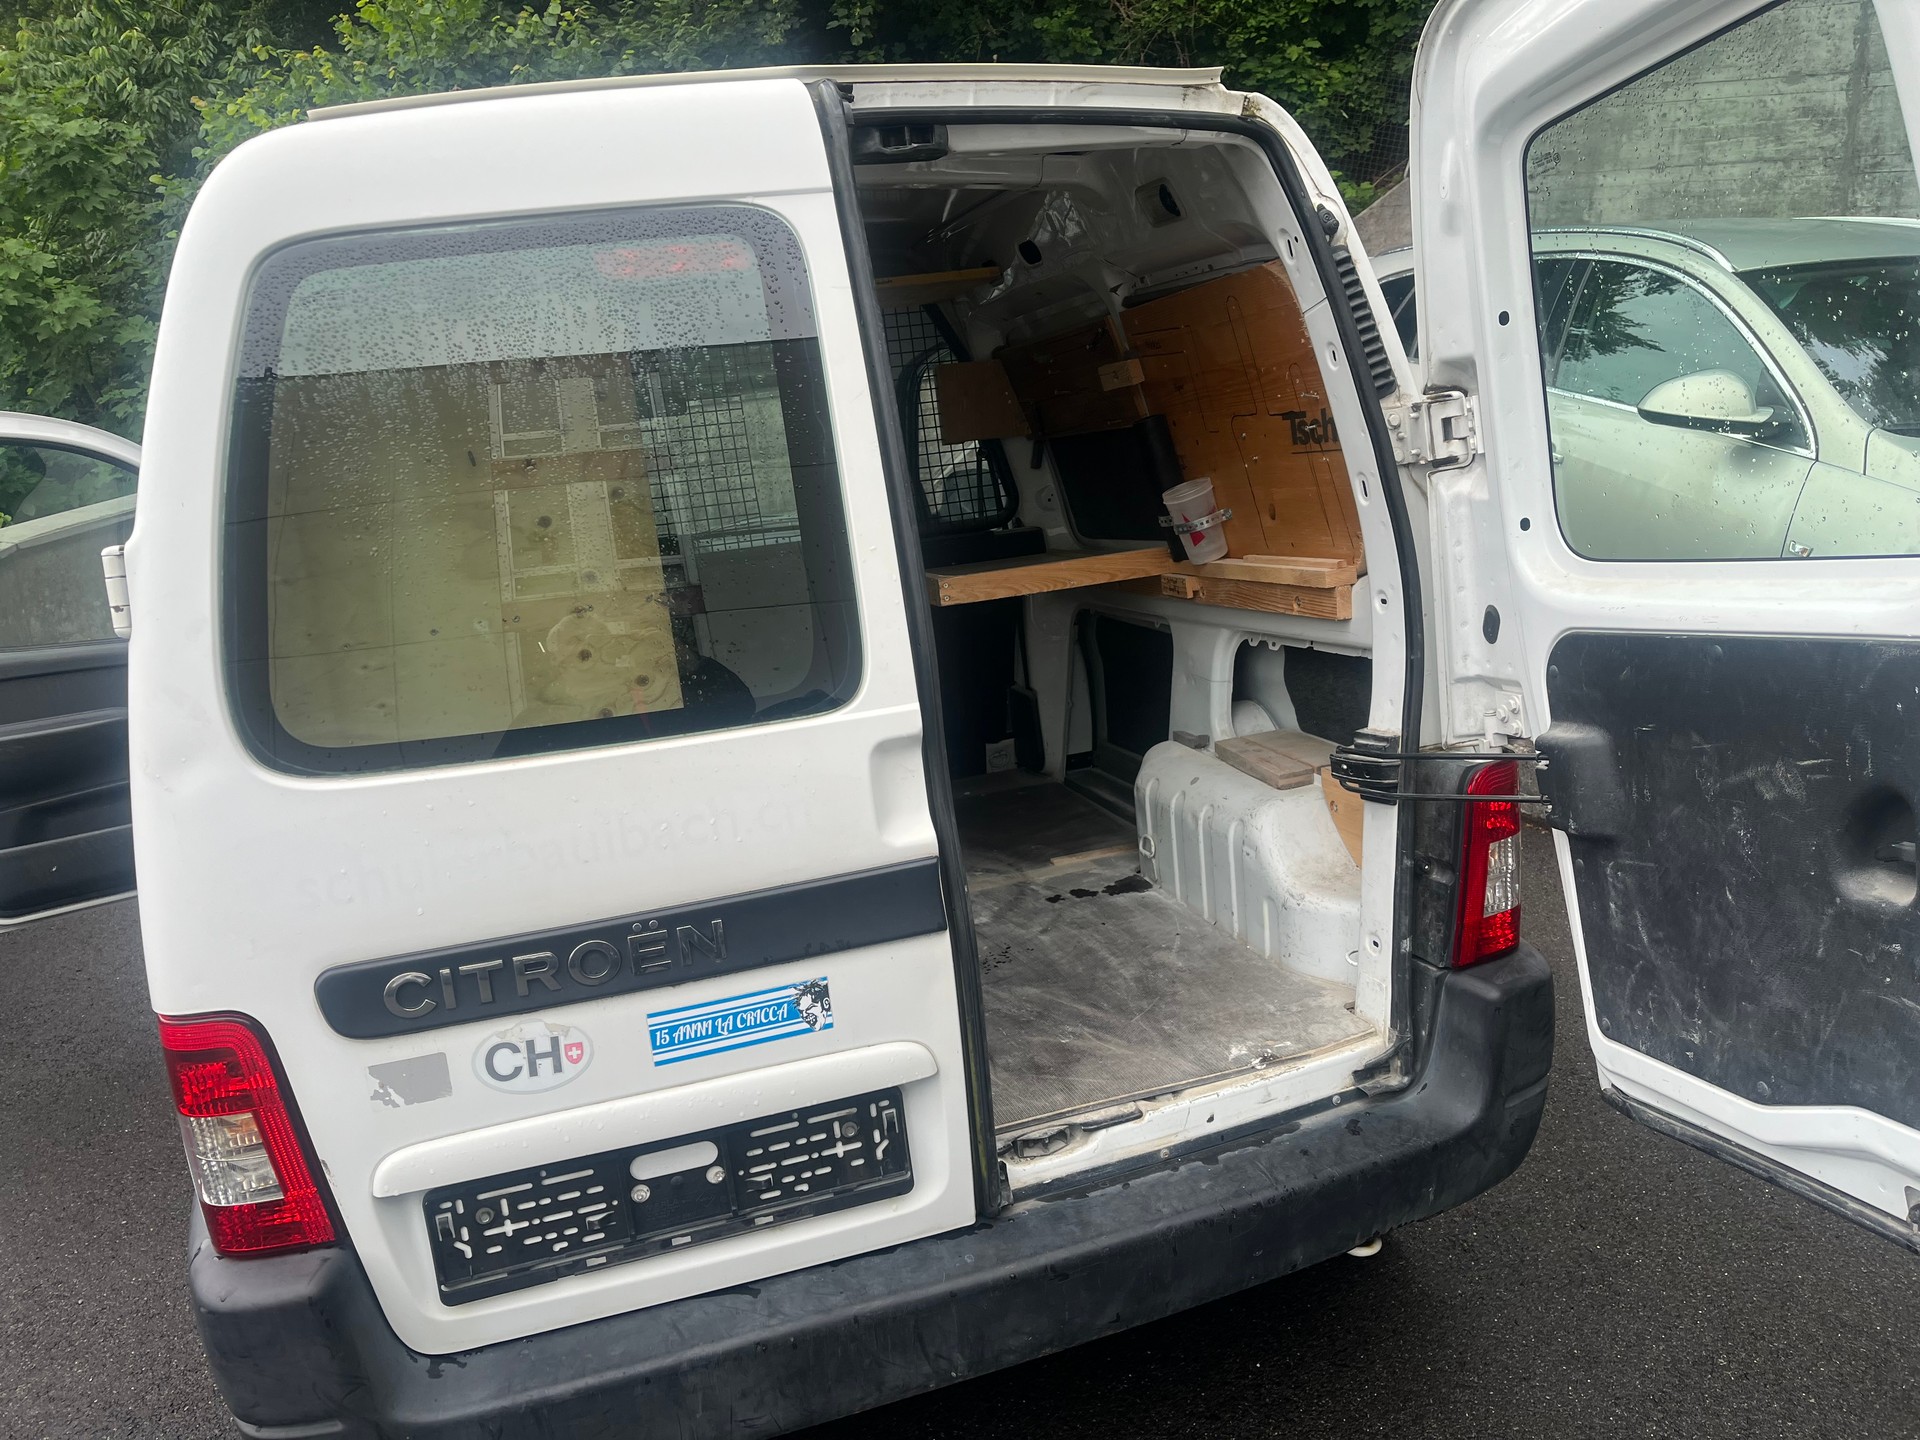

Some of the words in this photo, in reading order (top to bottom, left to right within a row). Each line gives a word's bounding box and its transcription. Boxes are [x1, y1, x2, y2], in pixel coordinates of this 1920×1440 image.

[383, 919, 727, 1019] CITROËN
[655, 1029, 670, 1046] 15
[672, 1022, 713, 1044] ANNI
[714, 1017, 734, 1036] LA
[736, 1003, 788, 1029] CRICCA
[484, 1036, 565, 1082] CH
